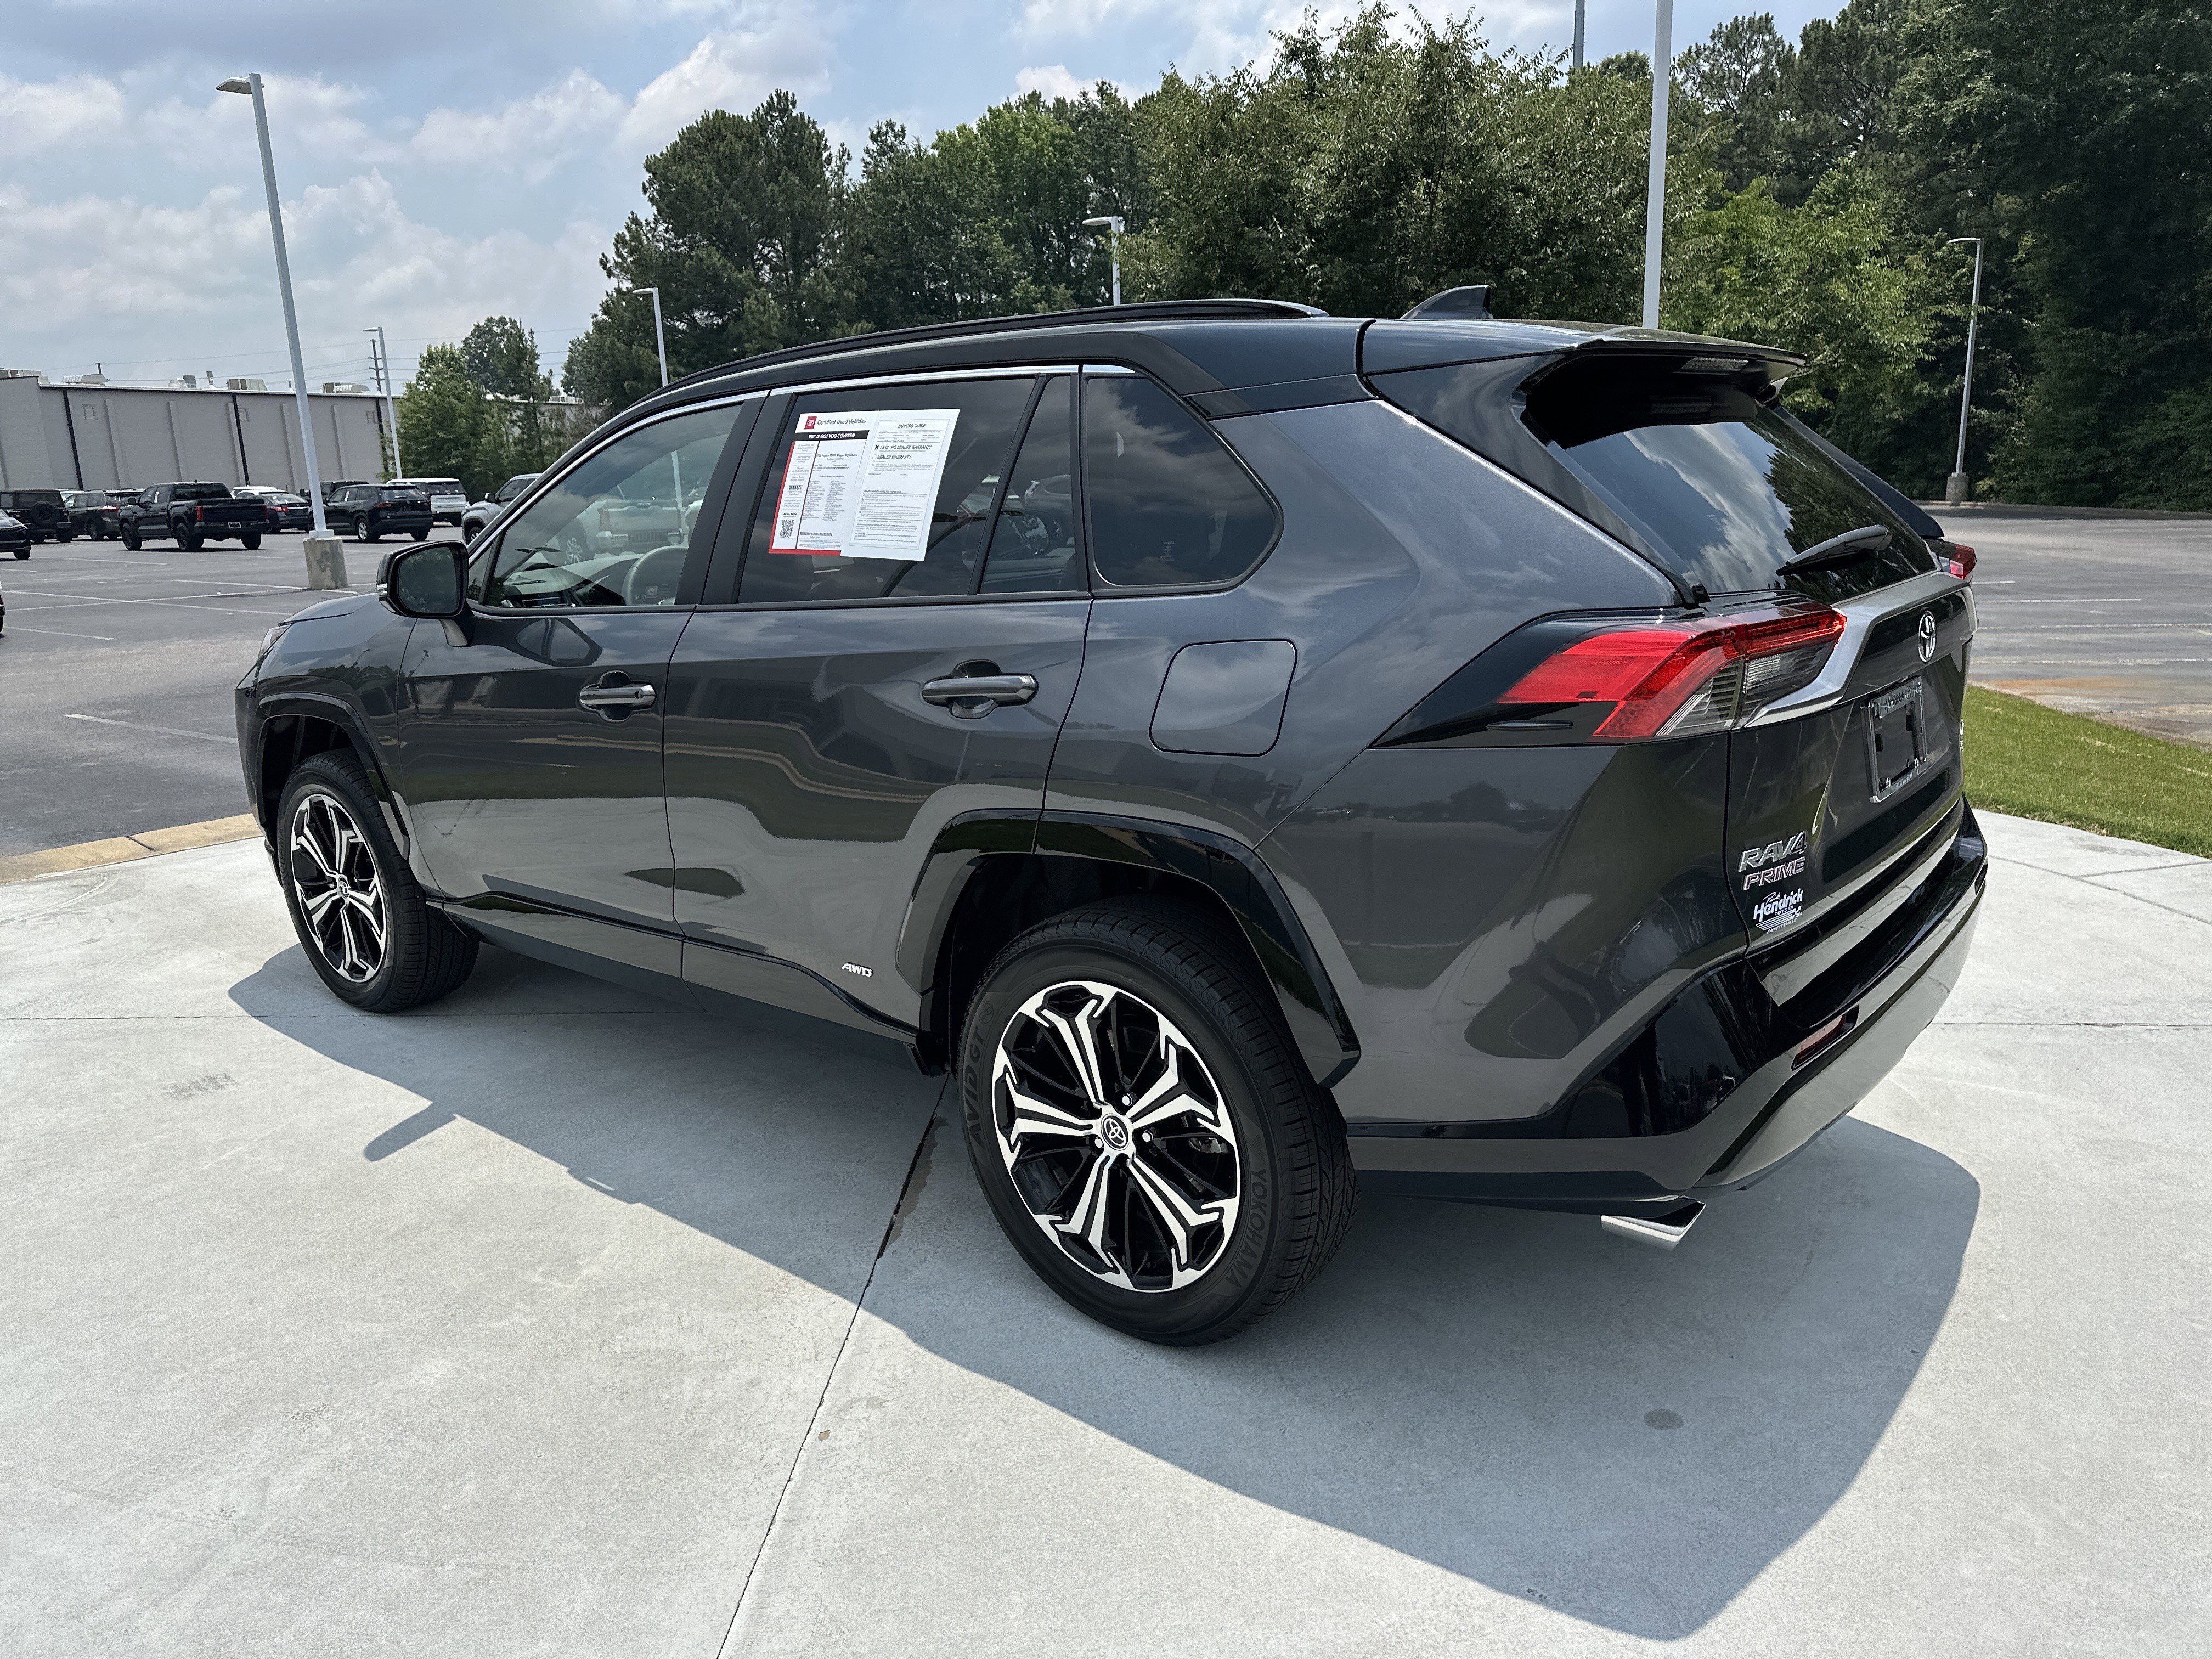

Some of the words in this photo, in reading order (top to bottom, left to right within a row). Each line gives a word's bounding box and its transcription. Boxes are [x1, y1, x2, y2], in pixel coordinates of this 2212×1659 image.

[1738, 831, 1807, 872] RAV4
[1743, 856, 1805, 891] PRIME
[1753, 888, 1804, 922] Hendrick
[1775, 906, 1794, 916] TOYOTA
[1767, 918, 1797, 934] FAYETTEVILLE
[841, 963, 873, 977] AWD
[969, 1025, 984, 1063] GT
[964, 1065, 986, 1150] AVID
[1225, 1169, 1268, 1288] YOKOHAMA
